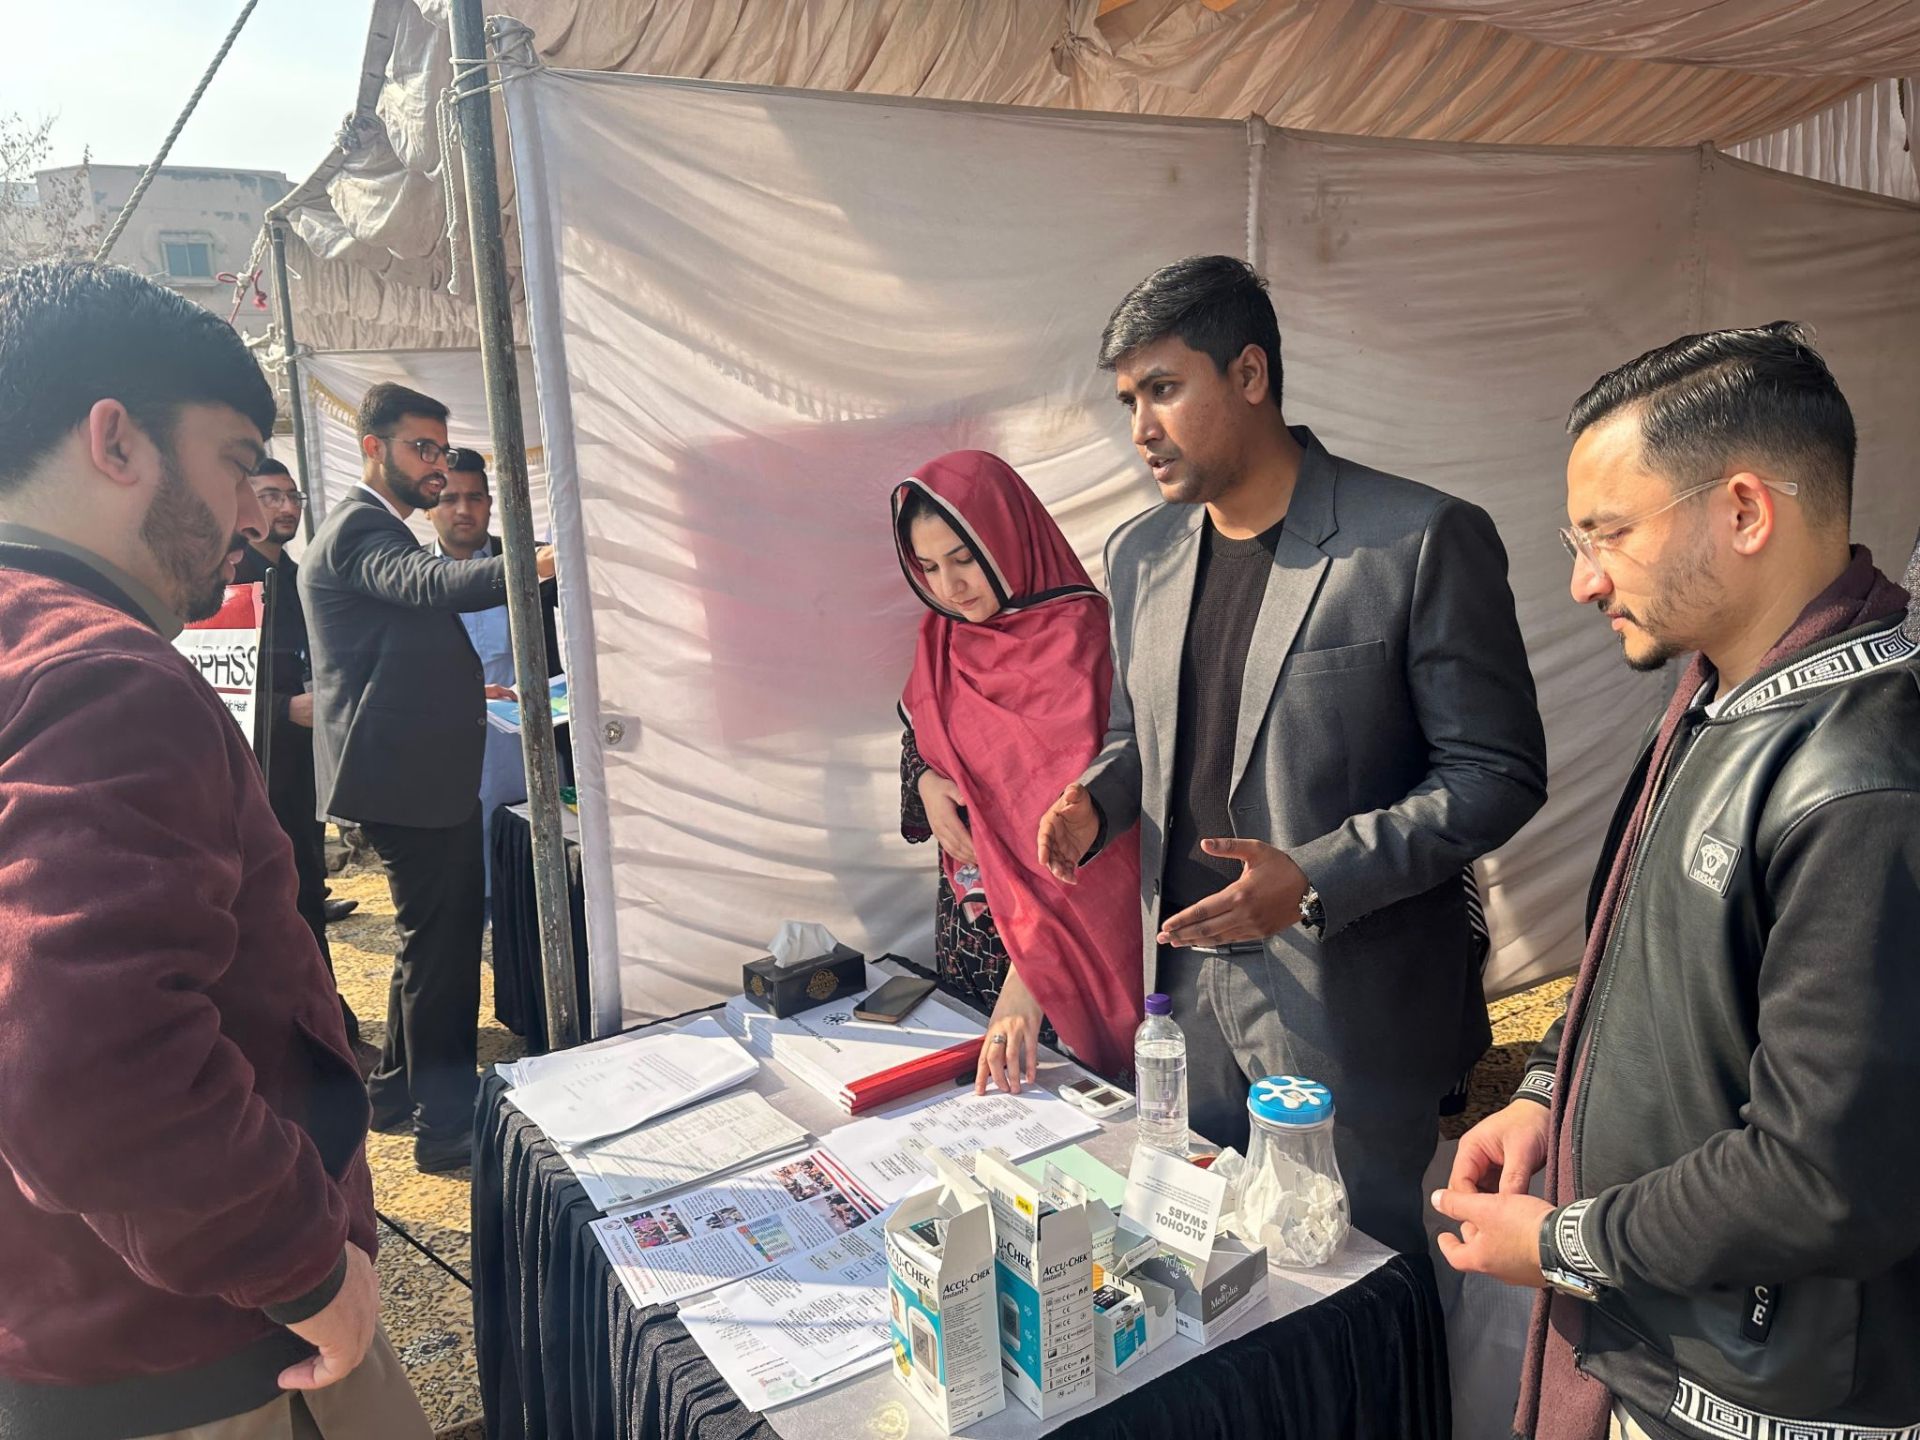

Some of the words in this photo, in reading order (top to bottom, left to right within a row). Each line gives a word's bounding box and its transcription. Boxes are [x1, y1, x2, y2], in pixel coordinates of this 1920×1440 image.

[1694, 868, 1721, 889] VERSACE
[1155, 1212, 1206, 1242] ALCOHOL
[1168, 1205, 1208, 1230] SWABS
[1042, 1255, 1088, 1277] ACCU-CHEK
[943, 1268, 991, 1294] ACCU-CHEK
[943, 1289, 963, 1301] Instant
